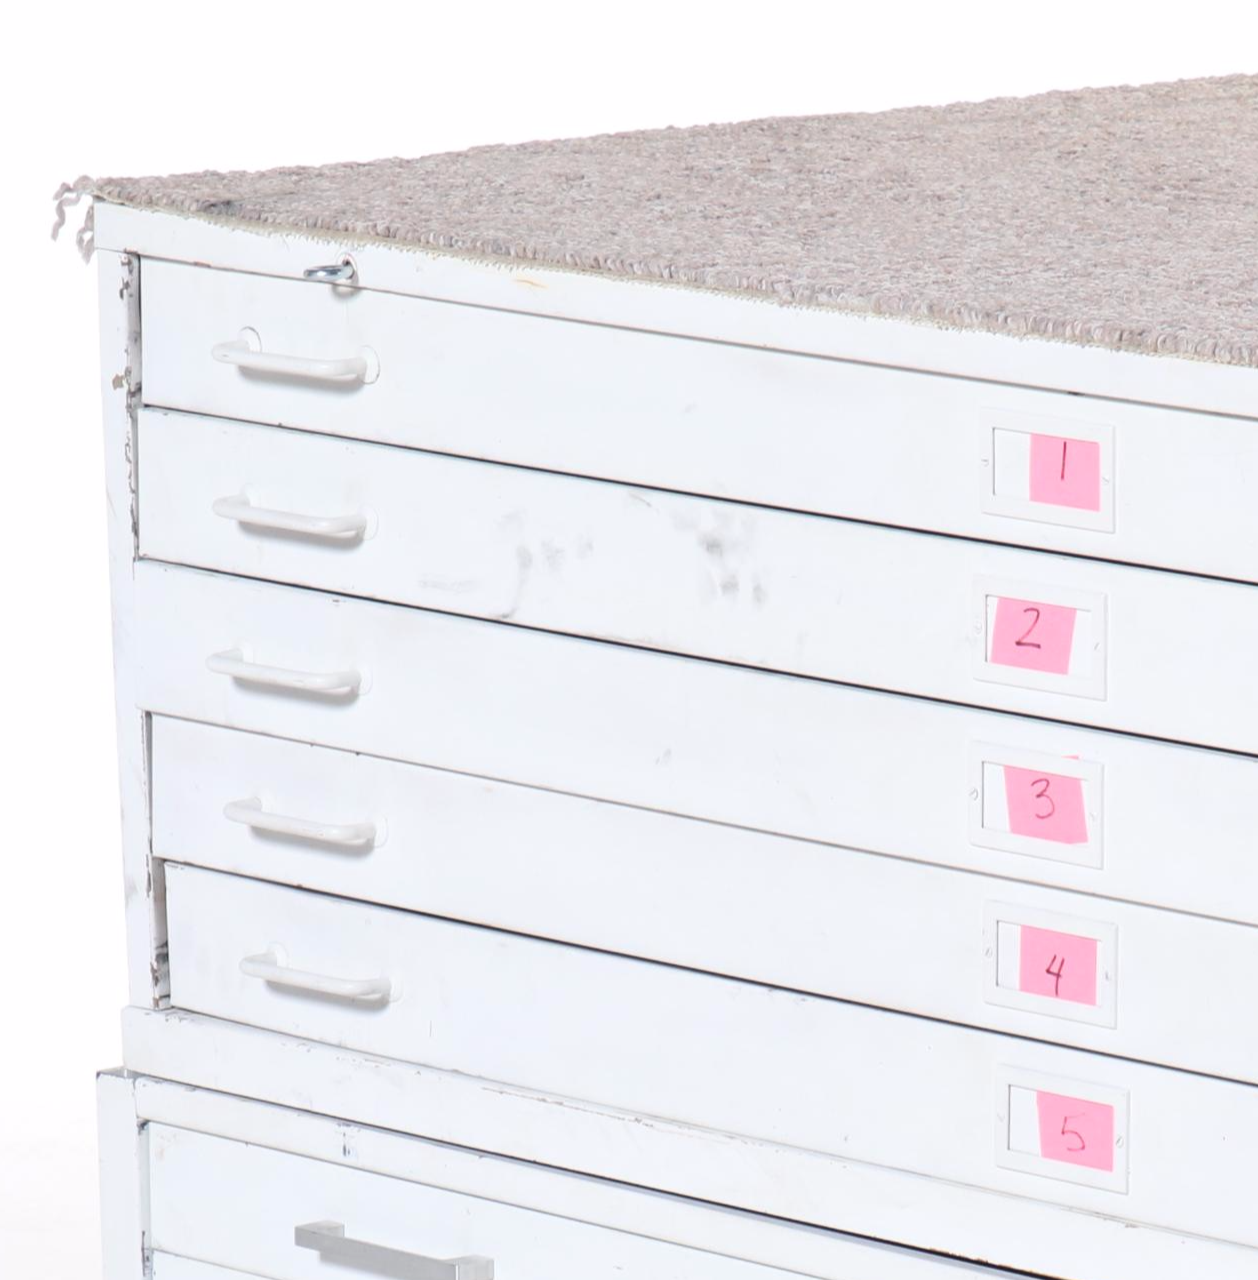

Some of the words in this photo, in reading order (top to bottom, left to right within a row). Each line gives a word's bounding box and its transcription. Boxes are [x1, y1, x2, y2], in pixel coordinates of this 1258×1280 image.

[1014, 607, 1042, 649] 2
[1031, 779, 1056, 820] 3
[1045, 954, 1064, 996] 4
[1062, 1112, 1085, 1152] 5
